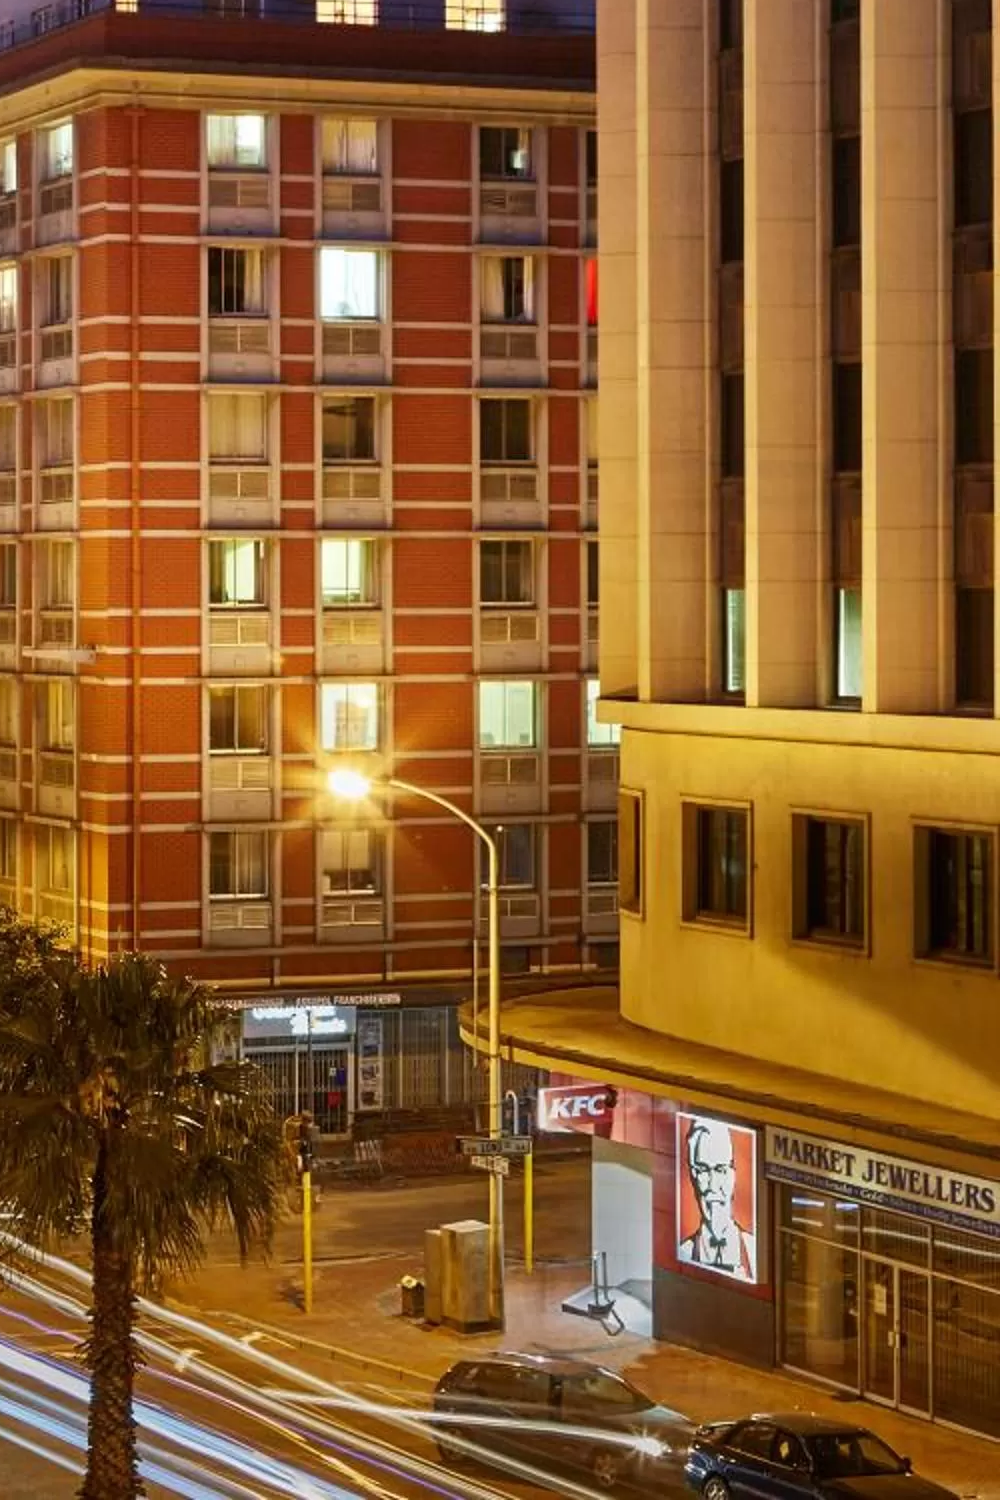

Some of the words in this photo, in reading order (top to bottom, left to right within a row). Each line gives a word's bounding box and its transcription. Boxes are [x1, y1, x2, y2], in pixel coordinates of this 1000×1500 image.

[550, 1094, 607, 1119] KFC
[773, 1135, 856, 1177] MARKET
[861, 1159, 996, 1213] JEWELLERS
